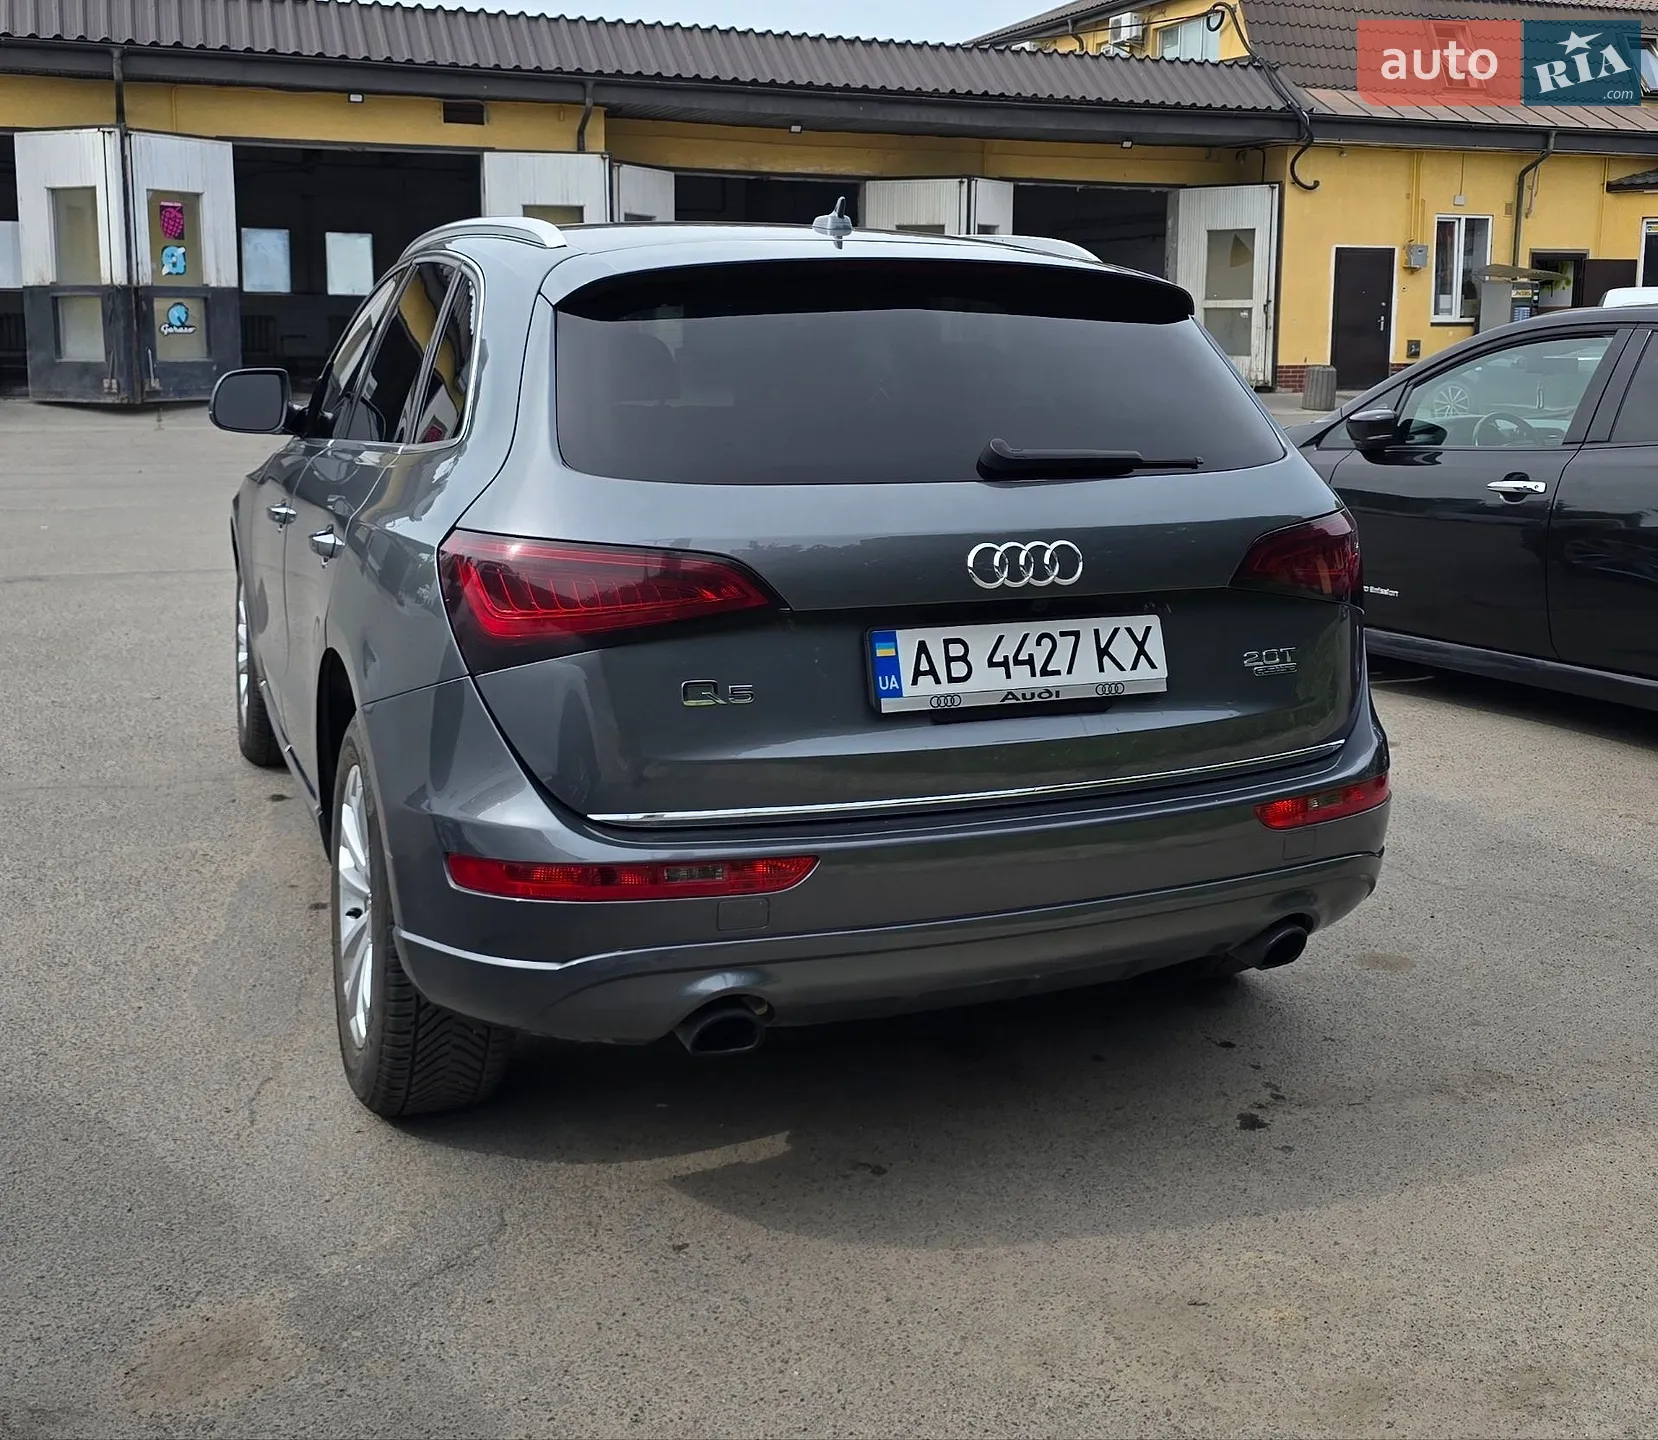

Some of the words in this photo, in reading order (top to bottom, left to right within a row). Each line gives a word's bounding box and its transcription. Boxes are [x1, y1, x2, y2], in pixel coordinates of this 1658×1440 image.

[911, 639, 973, 687] AB
[987, 630, 1081, 680] 4427
[1093, 625, 1158, 673] KX
[681, 679, 754, 706] Q5
[878, 675, 900, 690] UA
[999, 688, 1060, 703] Audi
